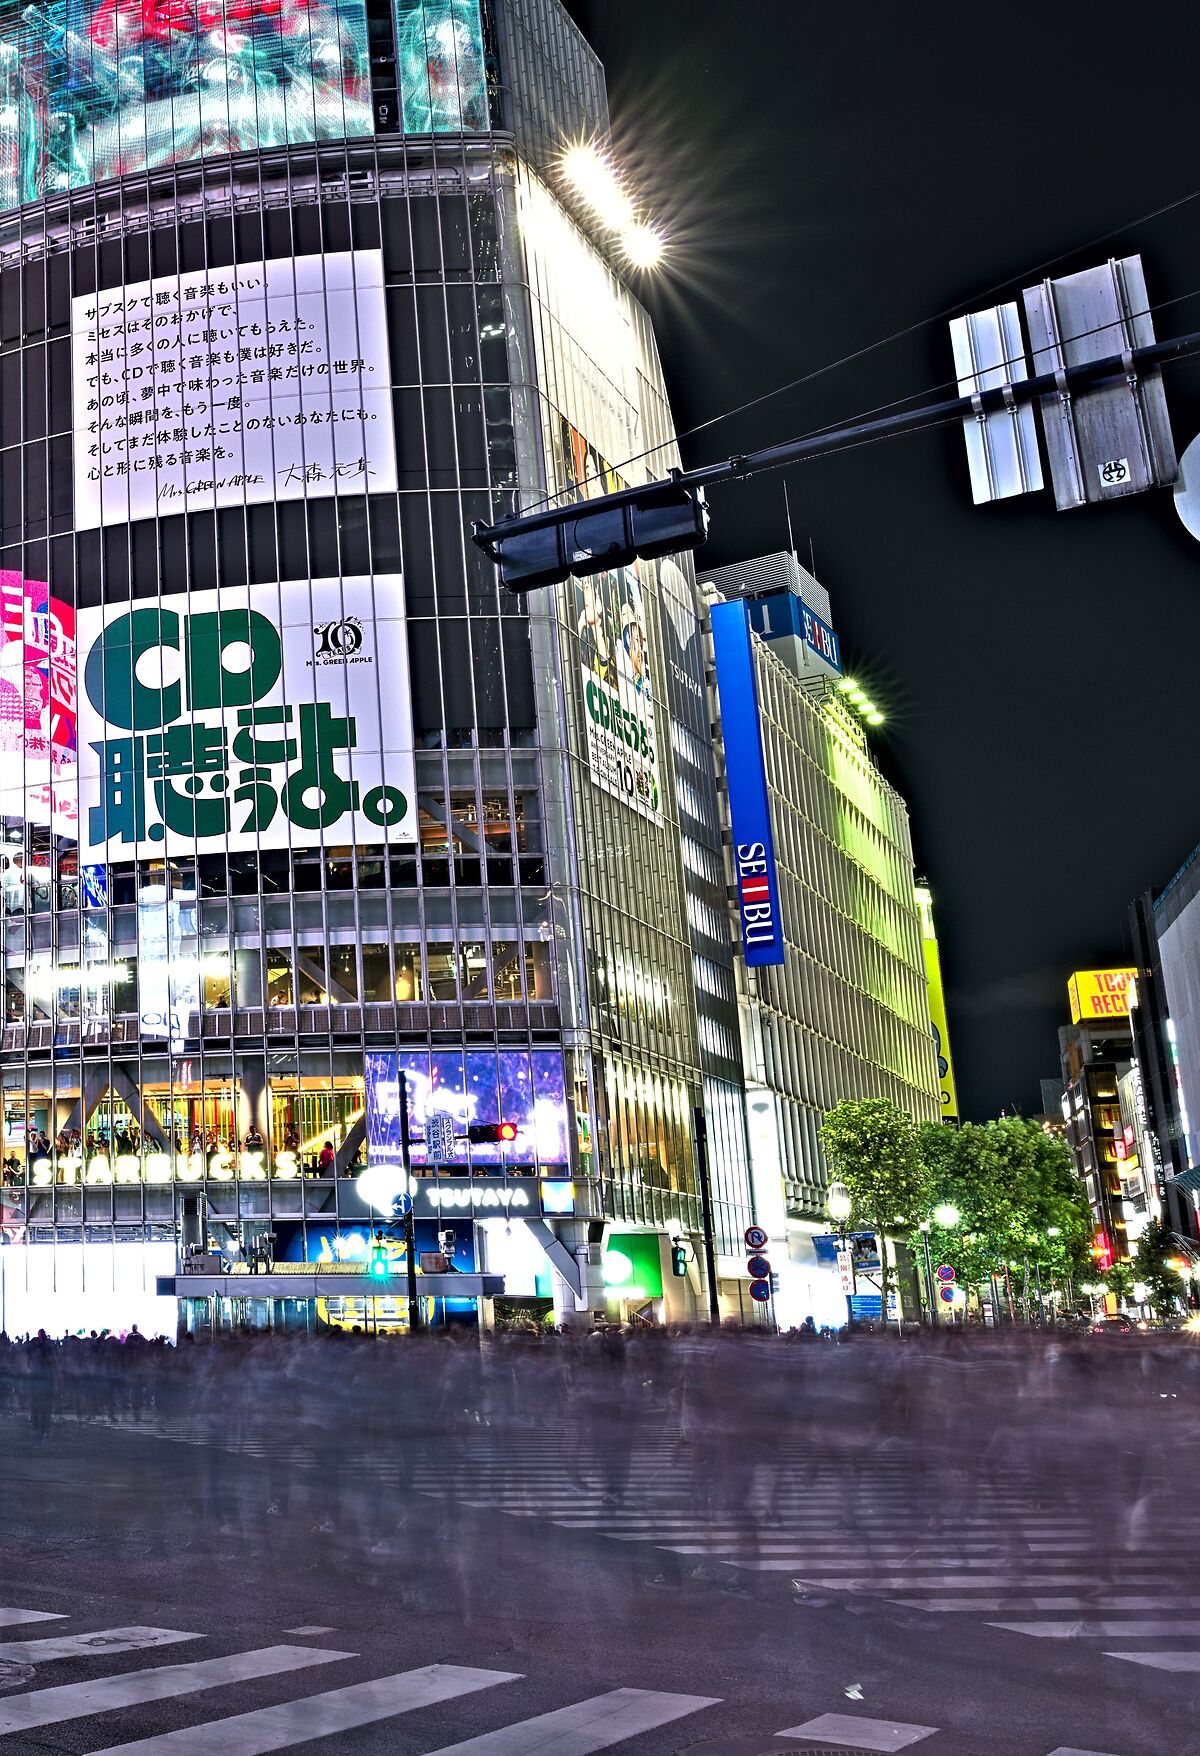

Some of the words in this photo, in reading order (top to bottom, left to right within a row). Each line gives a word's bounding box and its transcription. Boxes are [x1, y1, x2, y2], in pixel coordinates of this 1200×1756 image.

[87, 396, 251, 434] そんな瞬間を、もう一度。
[87, 446, 234, 480] 心と形に残る音楽を。
[84, 607, 283, 731] CD
[736, 842, 775, 947] SEIBU
[431, 1118, 442, 1160] 渋谷駅前
[32, 1150, 299, 1186] STARBUCKS
[426, 1187, 530, 1207] TSUTAYA
